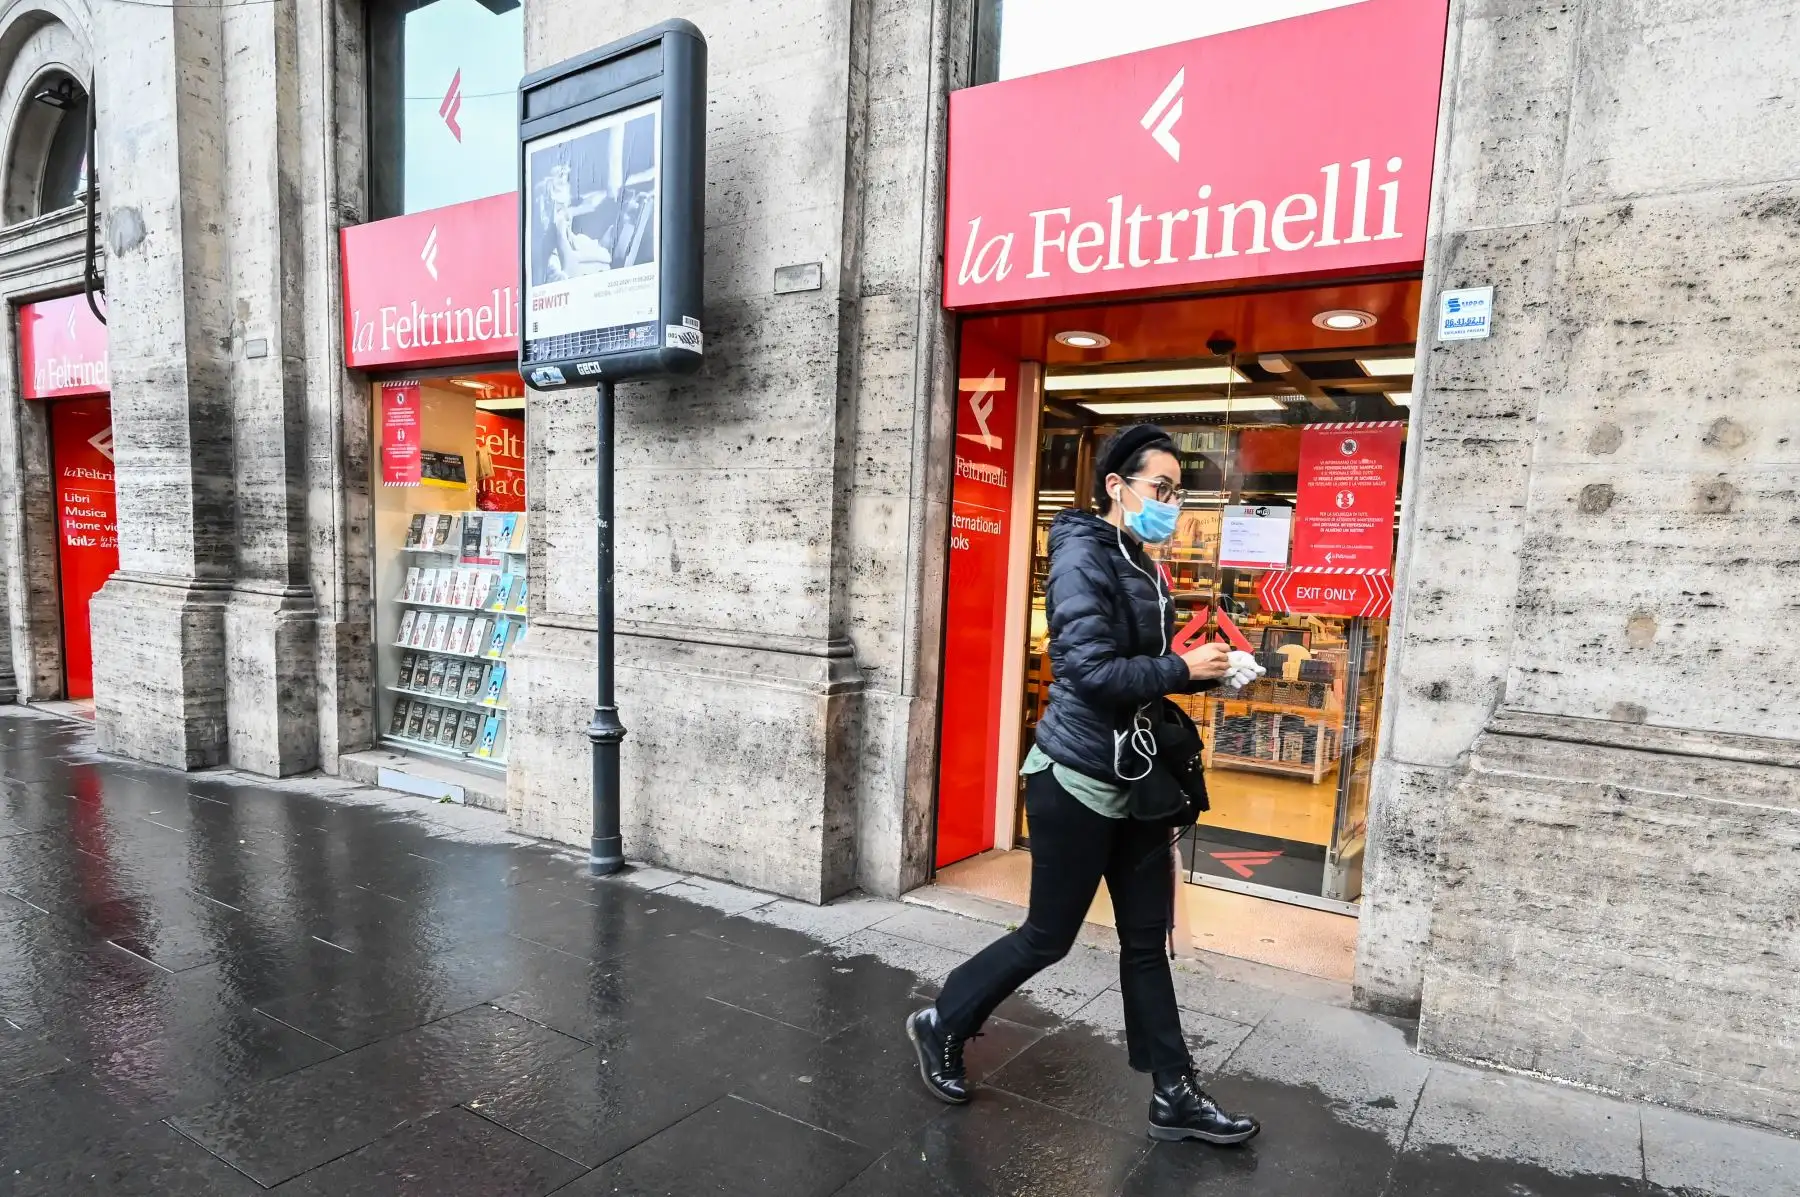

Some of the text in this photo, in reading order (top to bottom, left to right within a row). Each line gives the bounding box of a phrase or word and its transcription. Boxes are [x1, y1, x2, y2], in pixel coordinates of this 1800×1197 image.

[957, 156, 1404, 286] la Feltrinelli
[532, 291, 570, 312] ERWITT
[352, 309, 375, 353] la
[34, 350, 111, 390] la Feltrinel
[955, 454, 1007, 488] Feltrinelli
[64, 492, 90, 503] Libri
[65, 506, 107, 518] Musica
[66, 519, 100, 531] Home
[951, 511, 1001, 535] ternational
[950, 533, 970, 551] oks
[1296, 586, 1357, 601] EXIT ONLY
